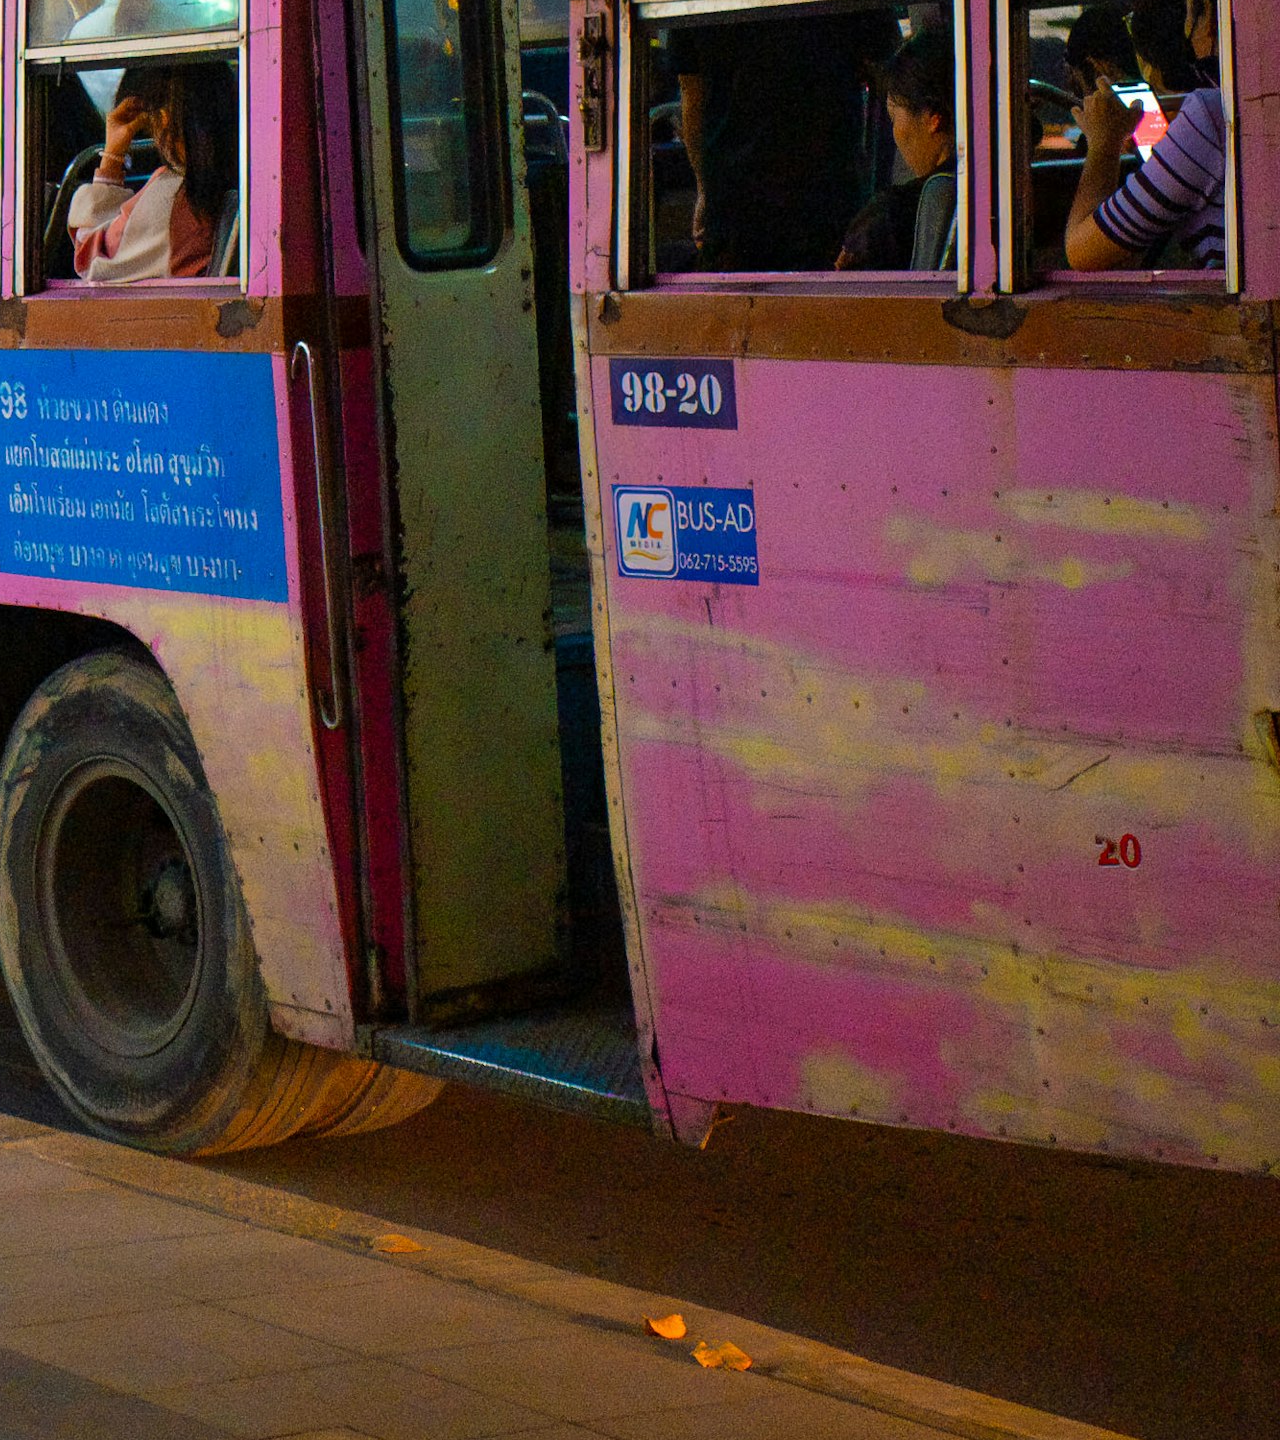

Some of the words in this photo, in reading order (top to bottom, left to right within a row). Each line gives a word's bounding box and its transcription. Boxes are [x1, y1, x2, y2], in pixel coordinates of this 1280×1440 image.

[620, 370, 723, 417] 98-20
[626, 501, 668, 540] NC
[676, 501, 754, 533] BUS-AD
[679, 553, 758, 574] 062-715-5595
[1095, 833, 1143, 870] 20
